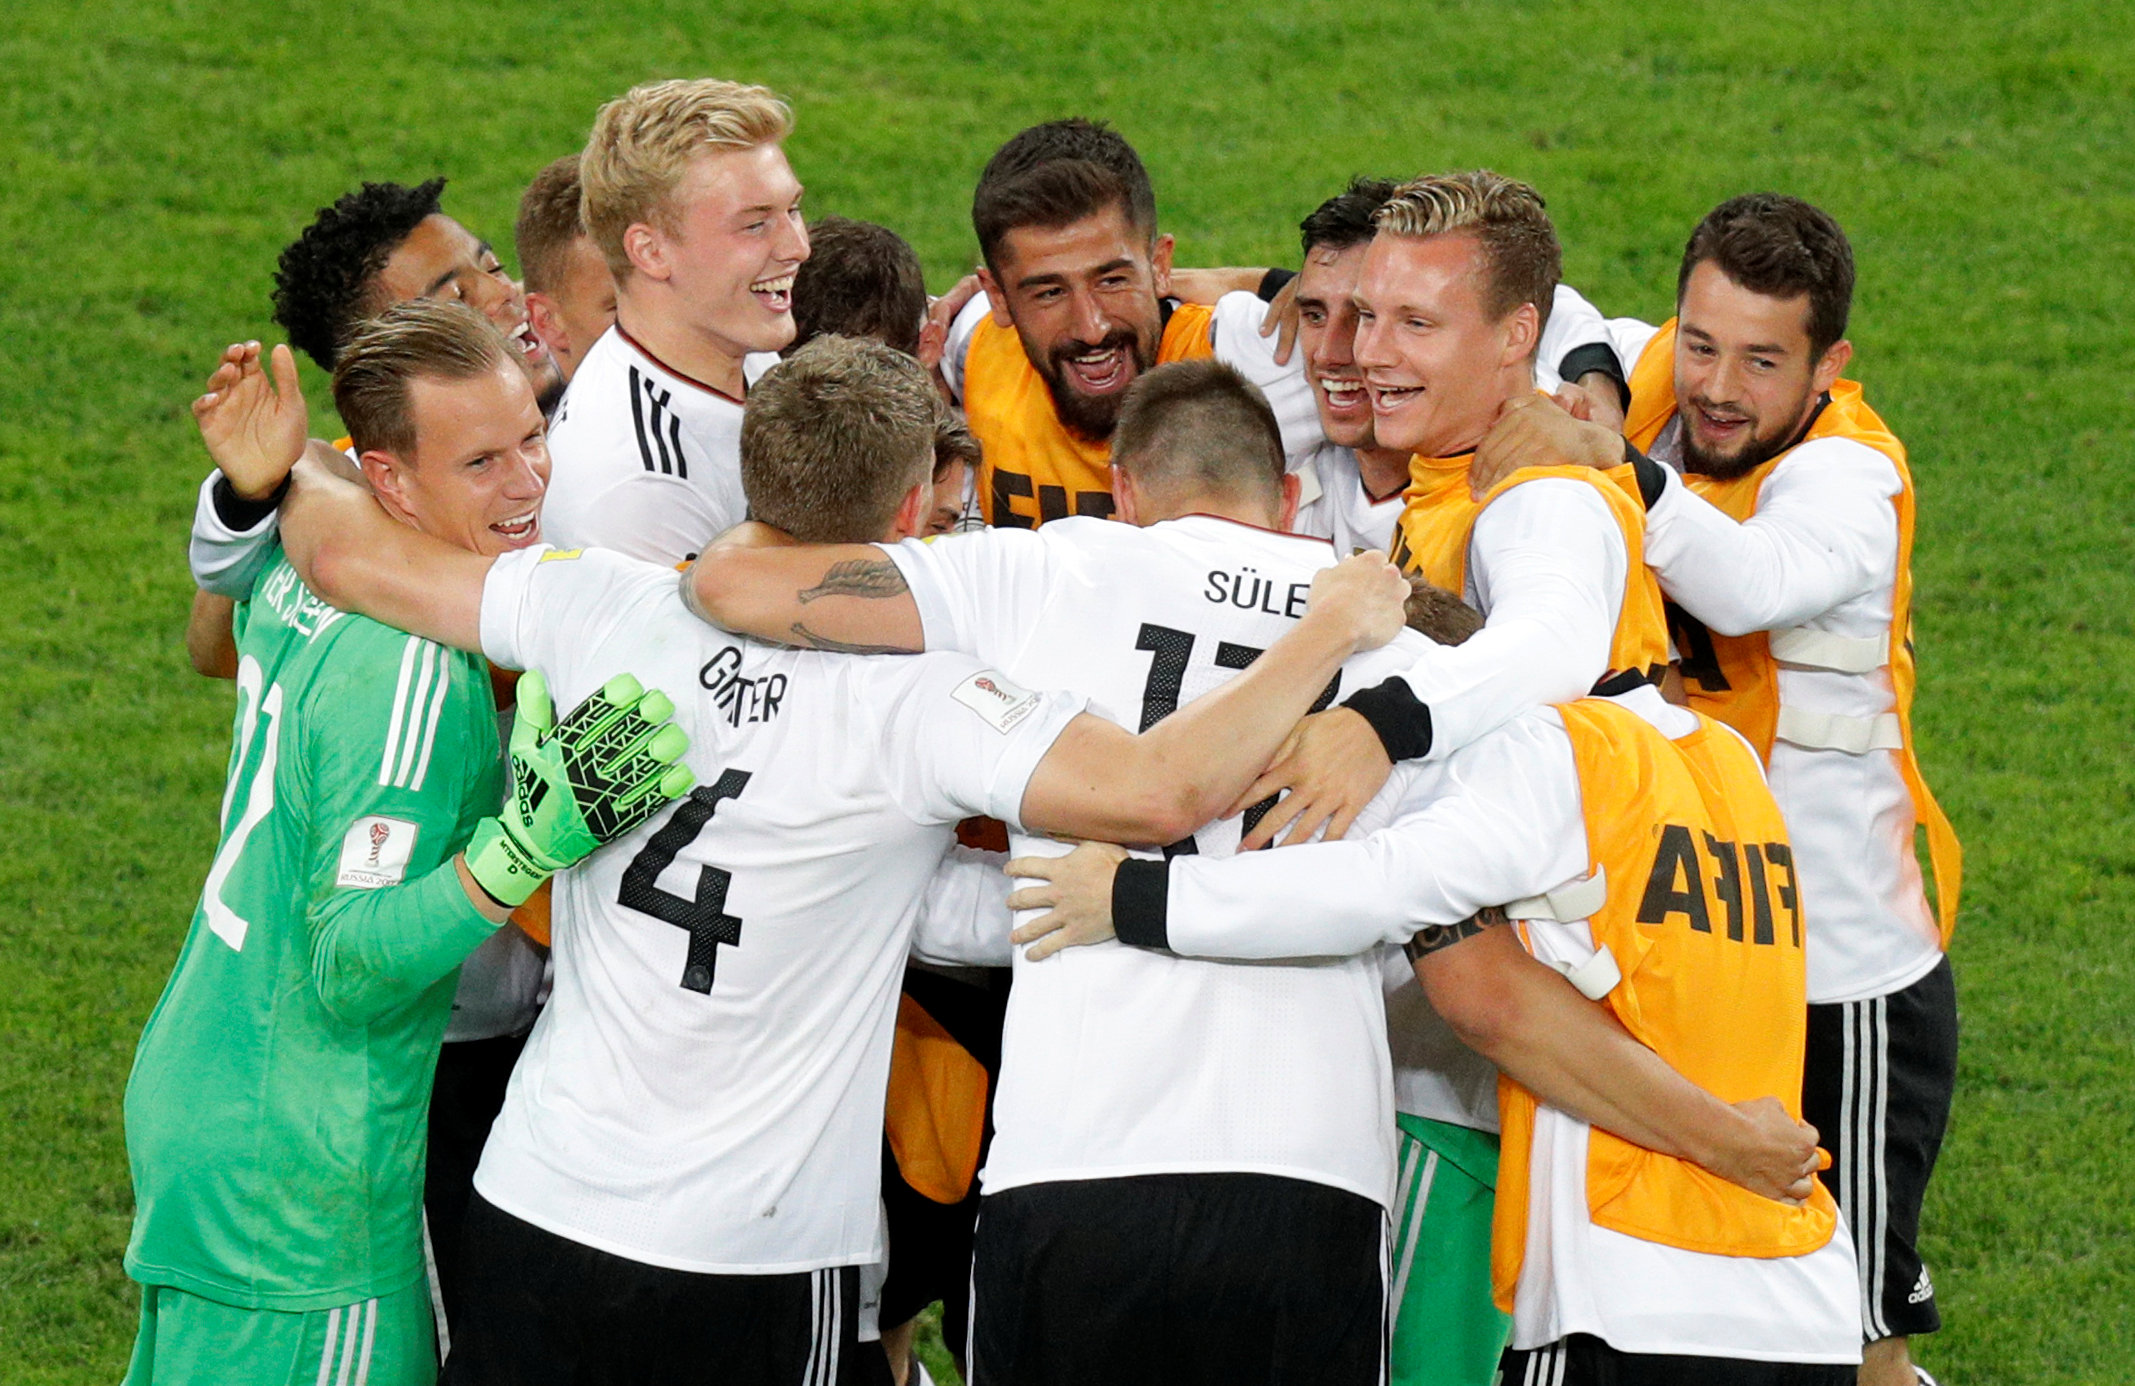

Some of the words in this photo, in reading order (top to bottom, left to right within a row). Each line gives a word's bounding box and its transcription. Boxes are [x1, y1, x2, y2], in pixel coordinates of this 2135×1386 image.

[1204, 566, 1311, 620] SÜLE
[511, 755, 534, 828] adidas
[340, 873, 375, 885] RUSSIA
[617, 768, 753, 996] 4
